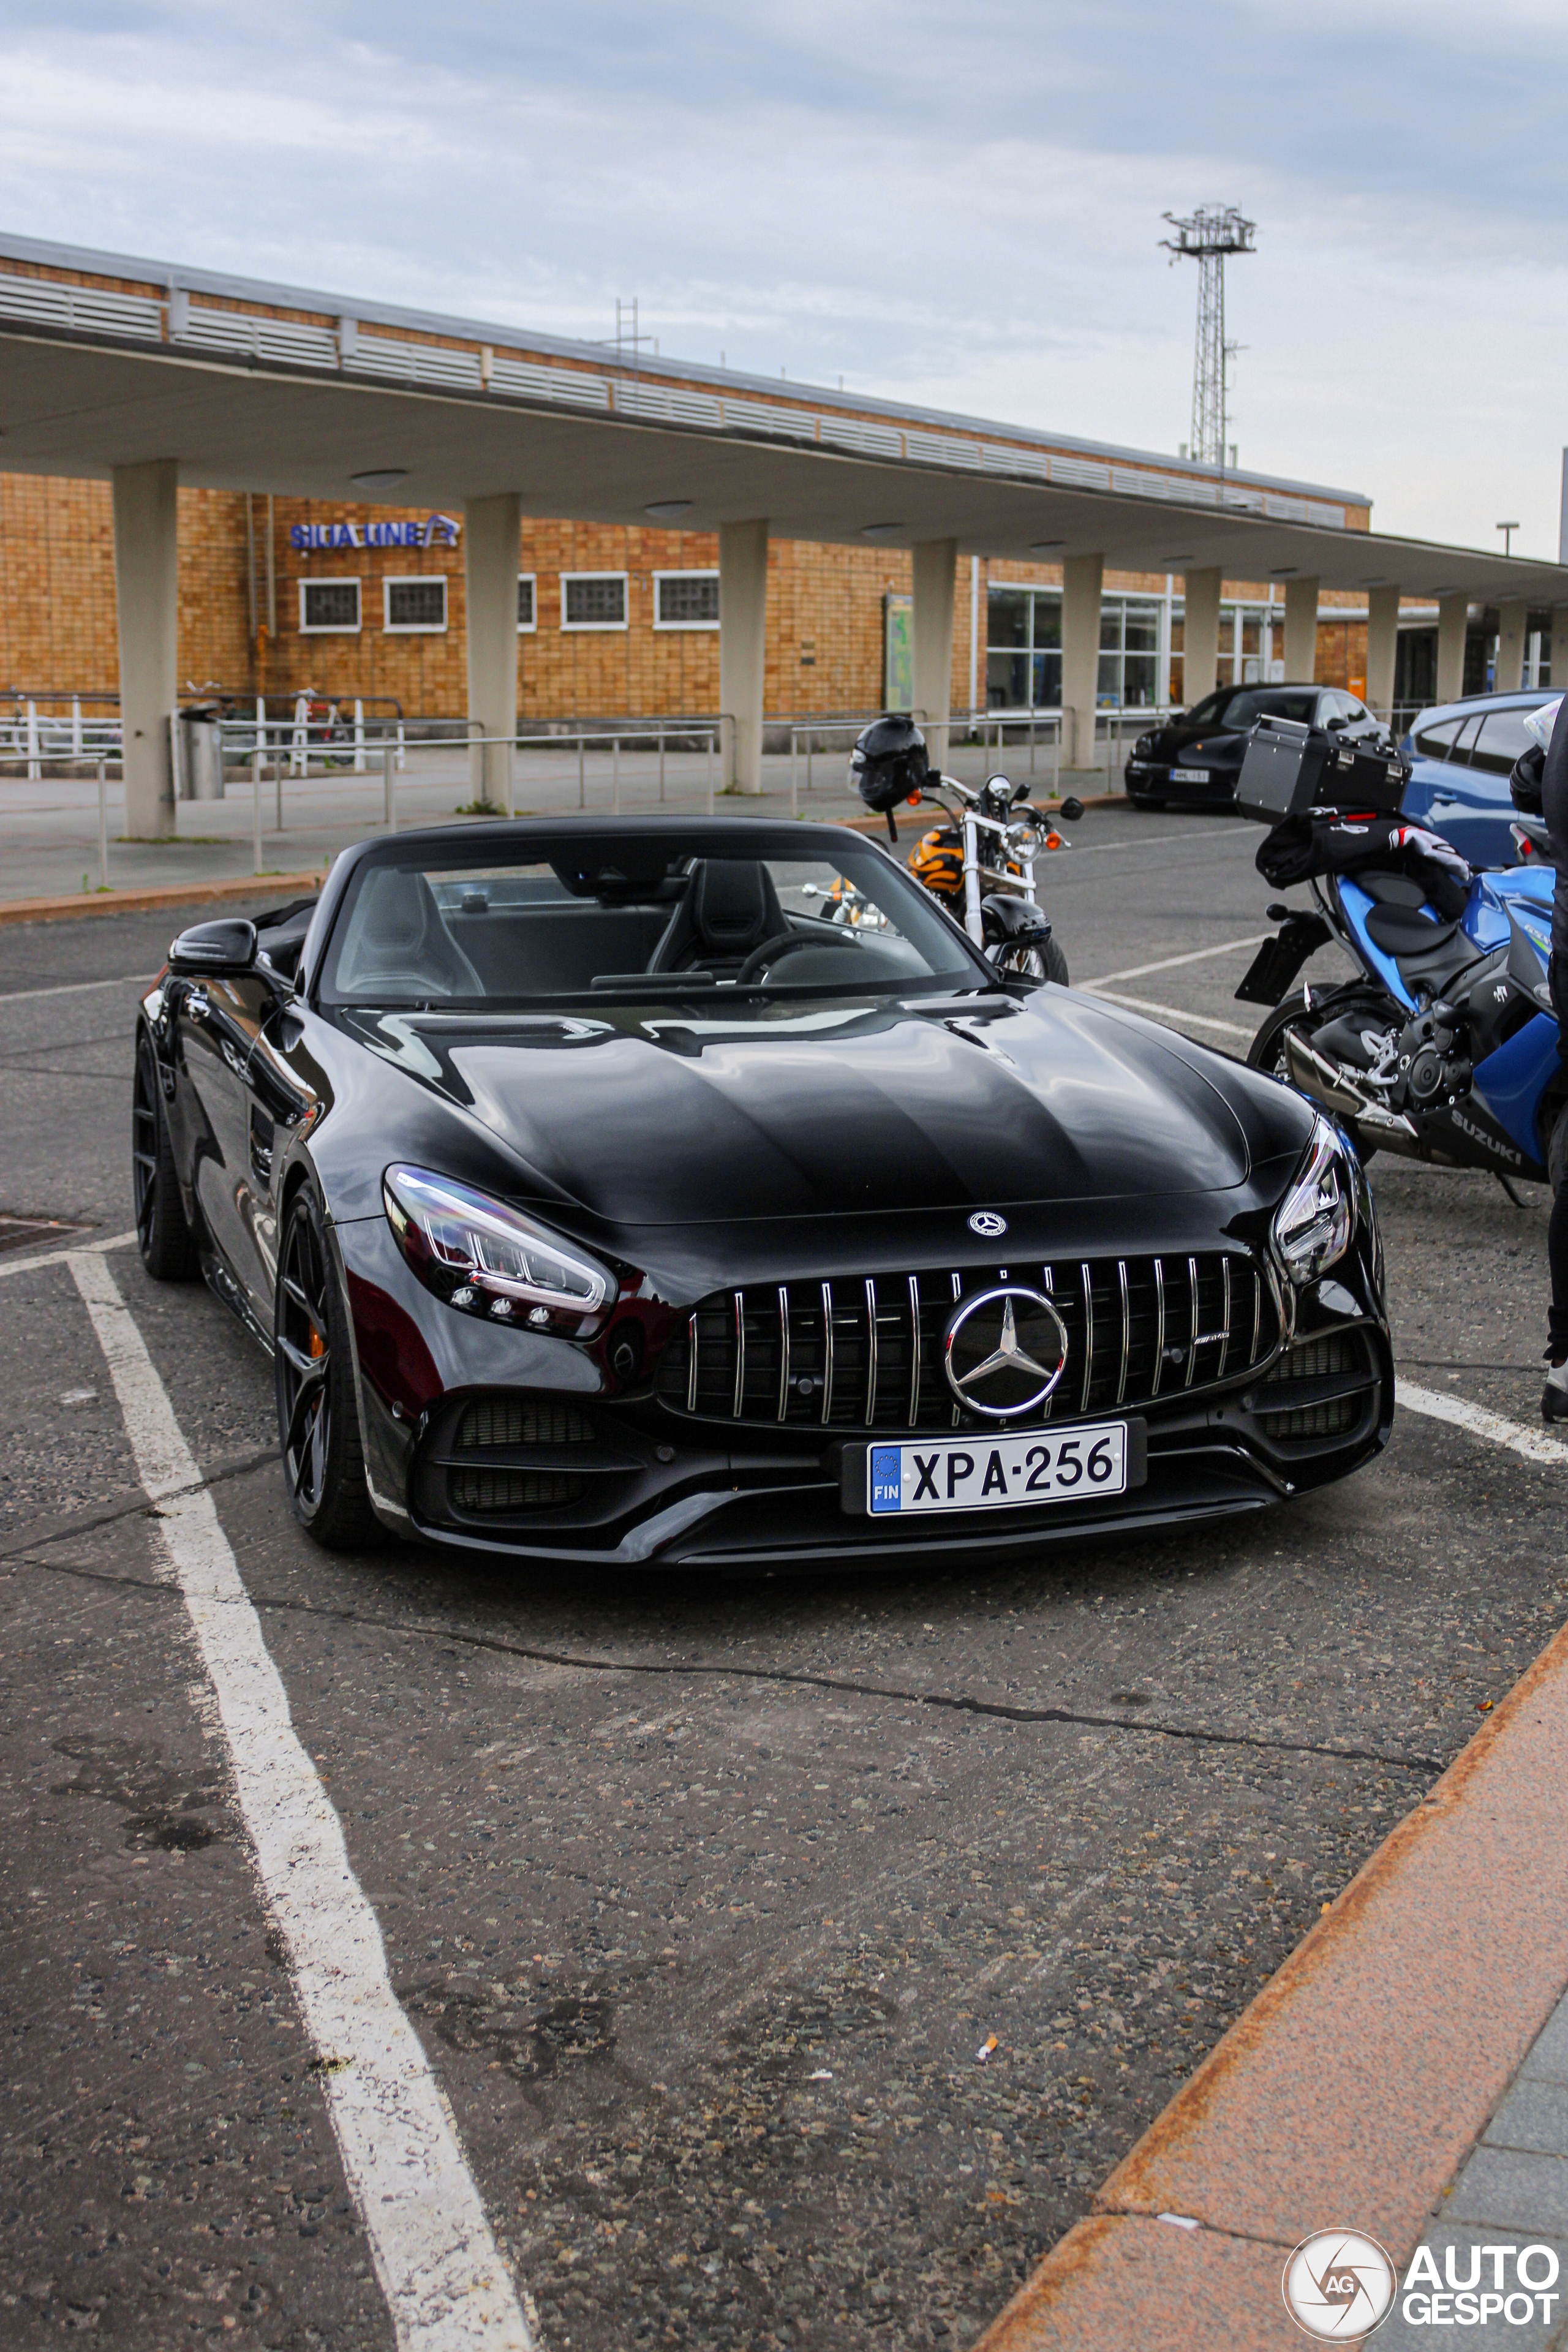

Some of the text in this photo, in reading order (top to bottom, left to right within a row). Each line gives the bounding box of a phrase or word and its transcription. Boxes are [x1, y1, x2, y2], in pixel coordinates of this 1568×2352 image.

[364, 522, 425, 547] LINE
[1451, 1109, 1521, 1166] SUZUKI
[911, 1437, 1114, 1501] XPA-256
[874, 1484, 899, 1500] FIN
